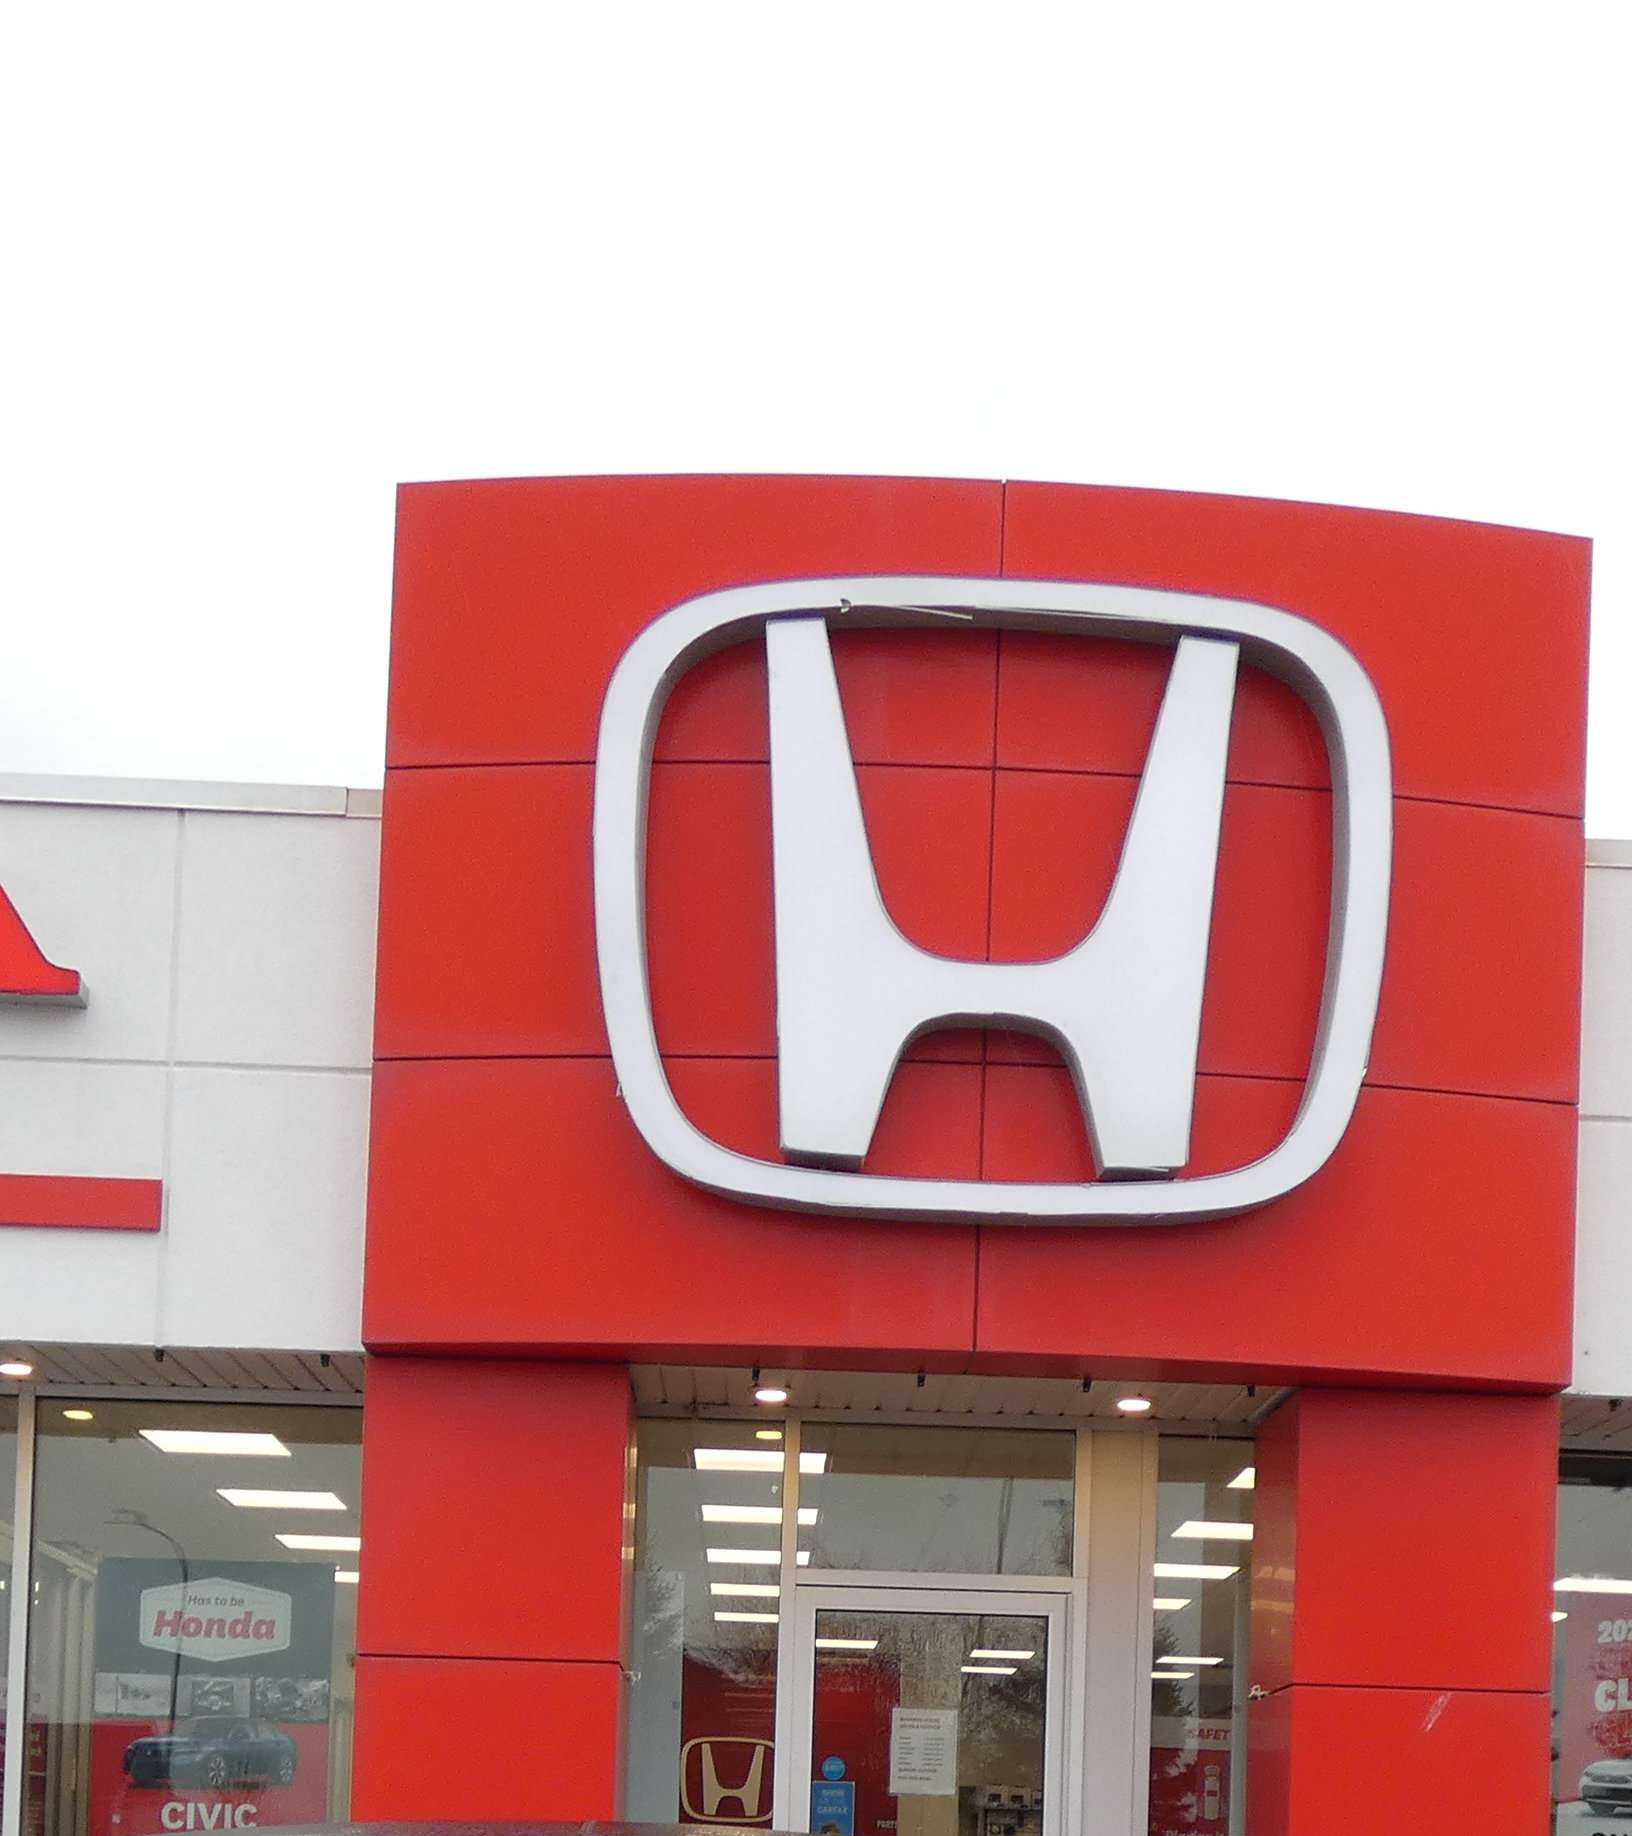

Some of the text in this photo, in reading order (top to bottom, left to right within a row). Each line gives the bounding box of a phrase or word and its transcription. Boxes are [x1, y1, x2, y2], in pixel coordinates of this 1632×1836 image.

[188, 1595, 245, 1606] Has to be
[153, 1610, 276, 1640] Honda
[161, 1801, 258, 1830] CIVIC
